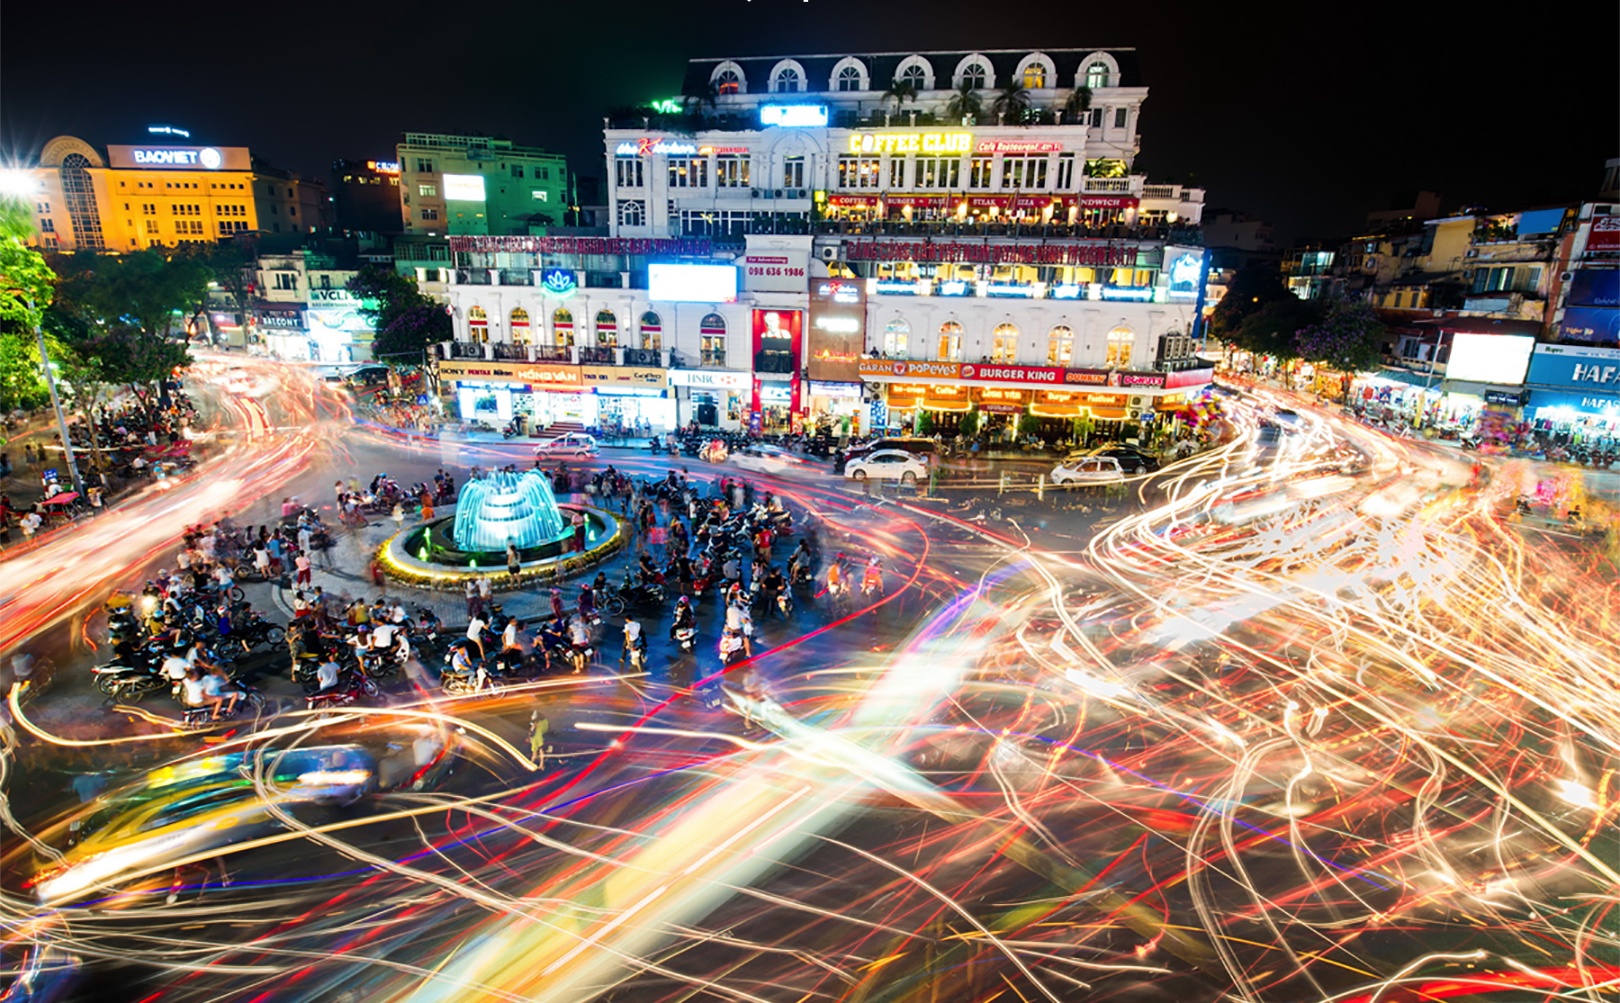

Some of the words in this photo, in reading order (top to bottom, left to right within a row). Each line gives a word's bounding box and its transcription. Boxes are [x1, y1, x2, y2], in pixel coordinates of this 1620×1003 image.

[849, 134, 923, 152] COFFEE
[924, 134, 971, 152] CLUB
[840, 197, 867, 205] COFFEE
[888, 197, 915, 205] BURGER
[973, 197, 996, 206] STEAK
[1068, 198, 1121, 206] SNDWICH
[748, 267, 764, 276] 098
[765, 267, 782, 276] 636
[784, 268, 804, 277] 1986
[687, 374, 715, 385] HSBC
[980, 368, 1024, 379] BURGER
[1027, 370, 1055, 381] KING
[1122, 375, 1165, 385] DONUTS
[1047, 392, 1071, 402] Burger
